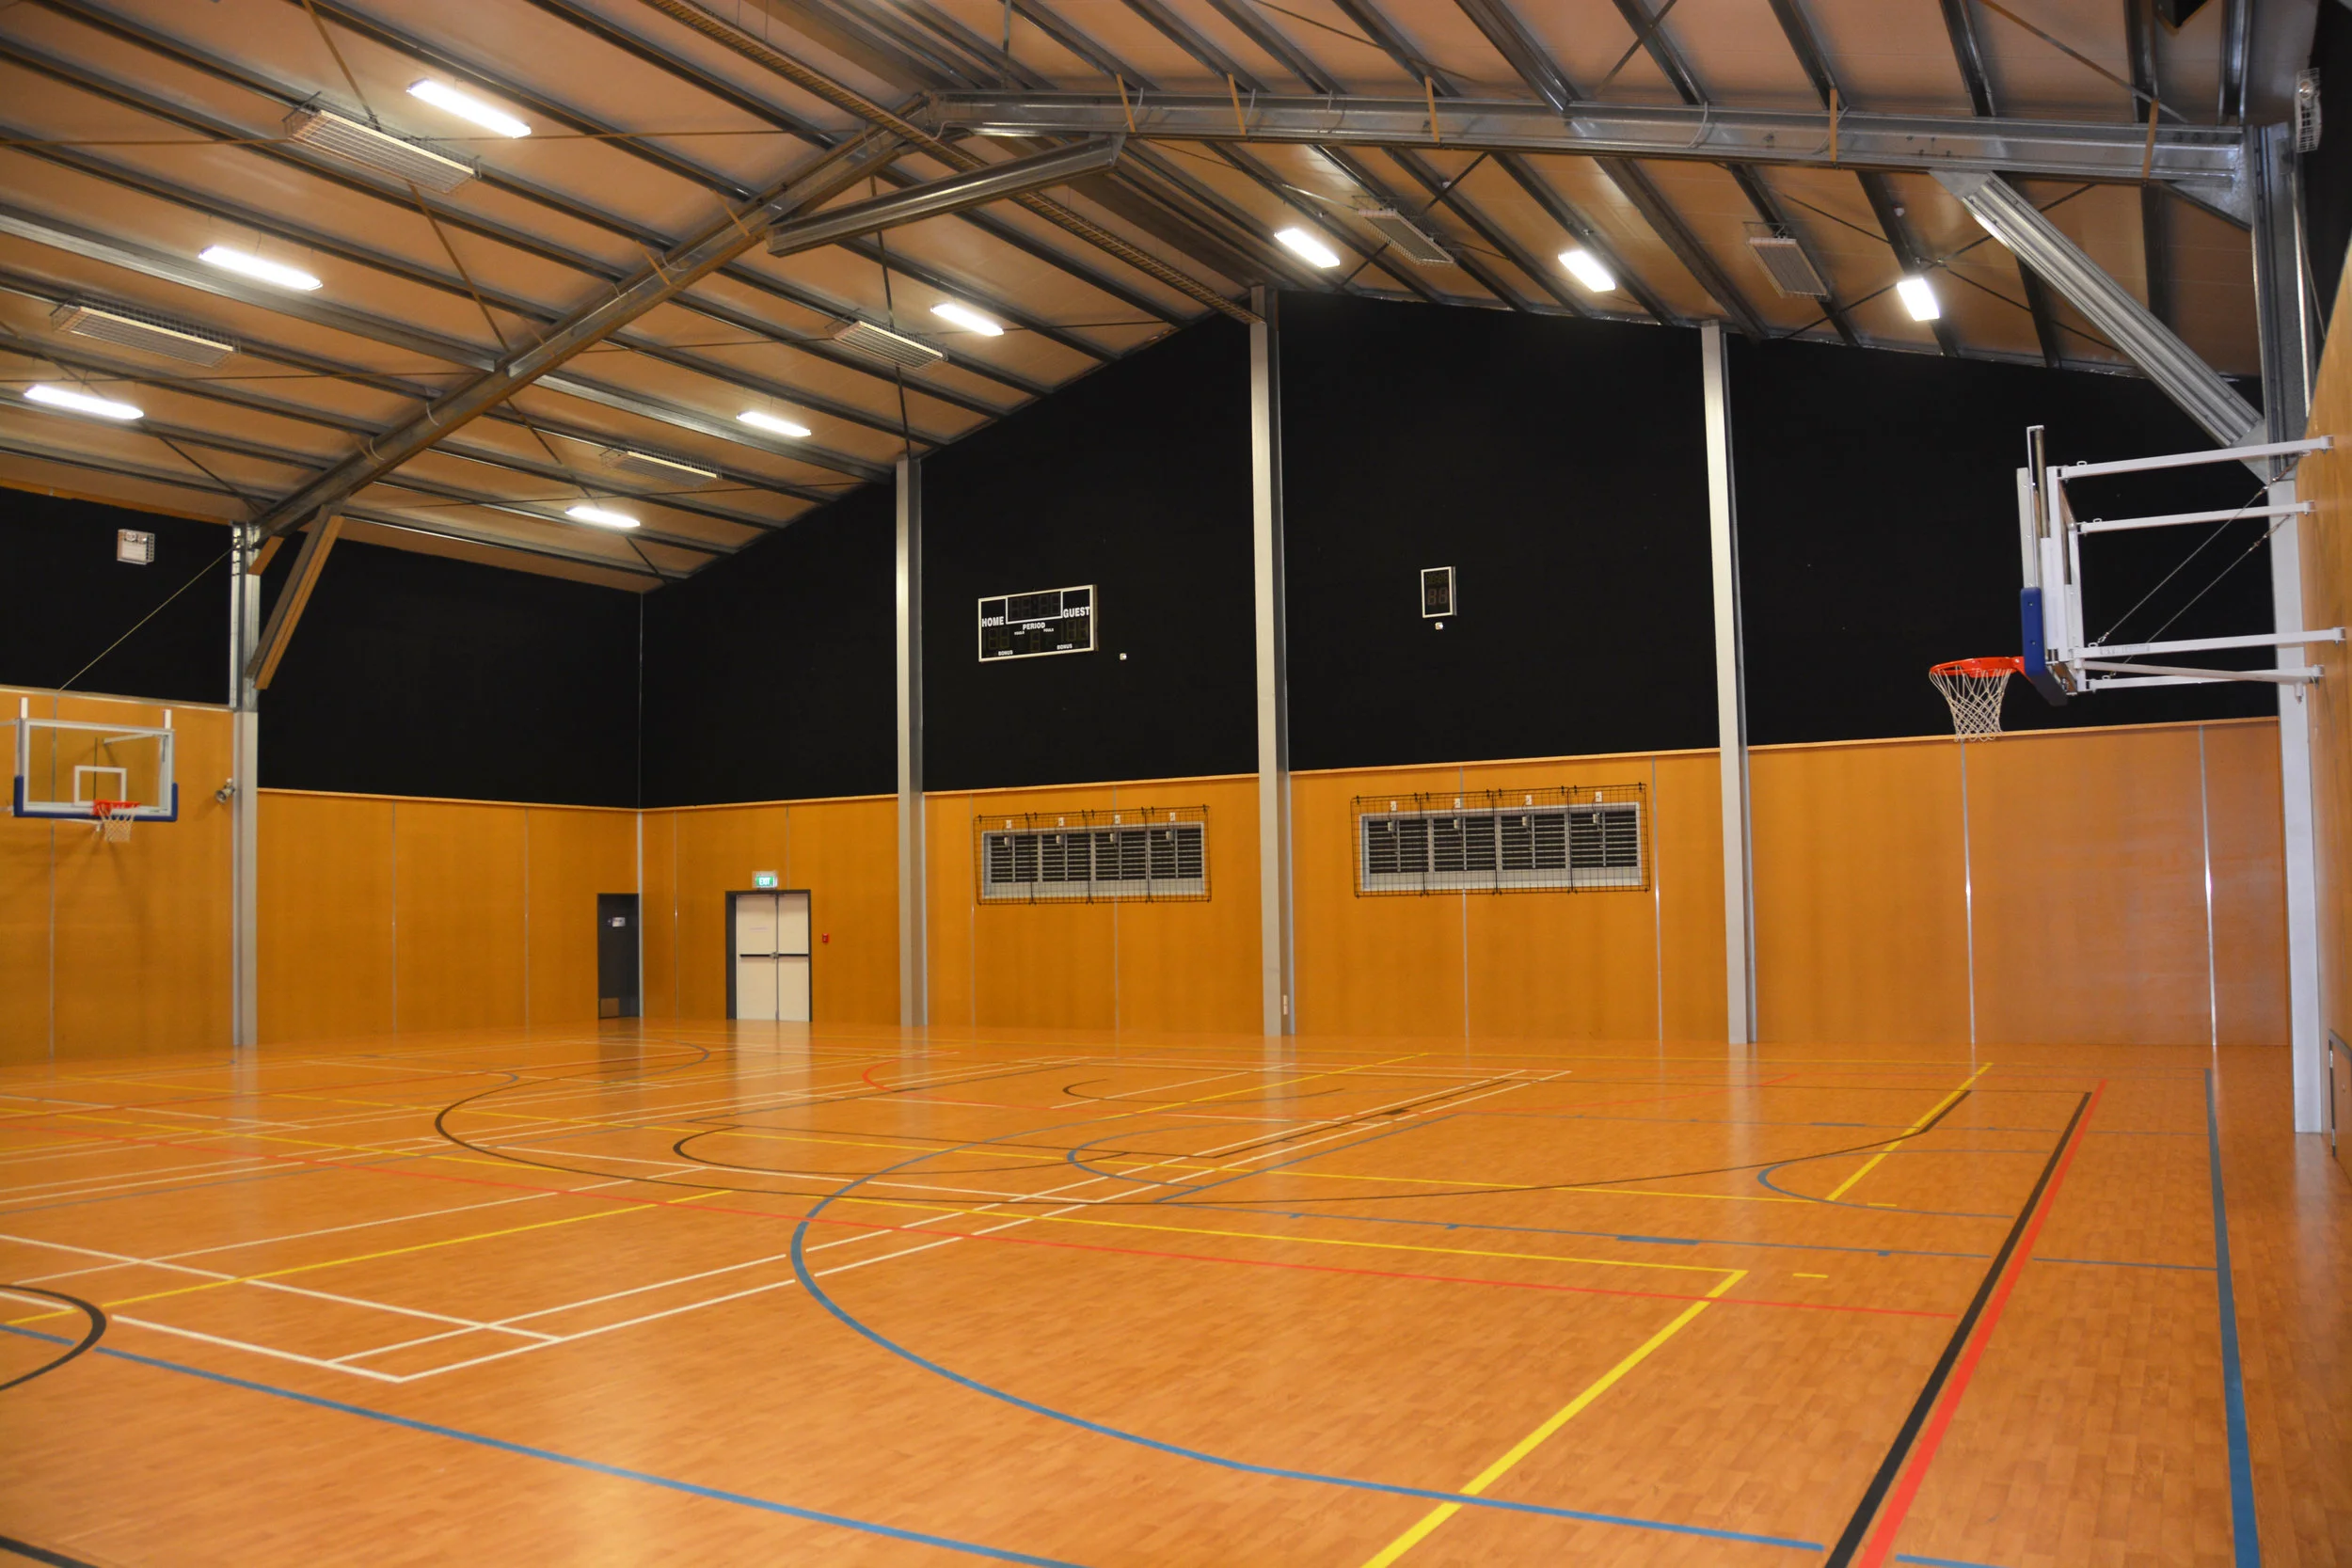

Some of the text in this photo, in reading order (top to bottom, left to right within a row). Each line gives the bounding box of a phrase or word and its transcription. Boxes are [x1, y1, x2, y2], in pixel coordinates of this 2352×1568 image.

[1063, 607, 1090, 618] GUEST
[981, 616, 1004, 627] HOME
[1023, 622, 1046, 630] PERIOD
